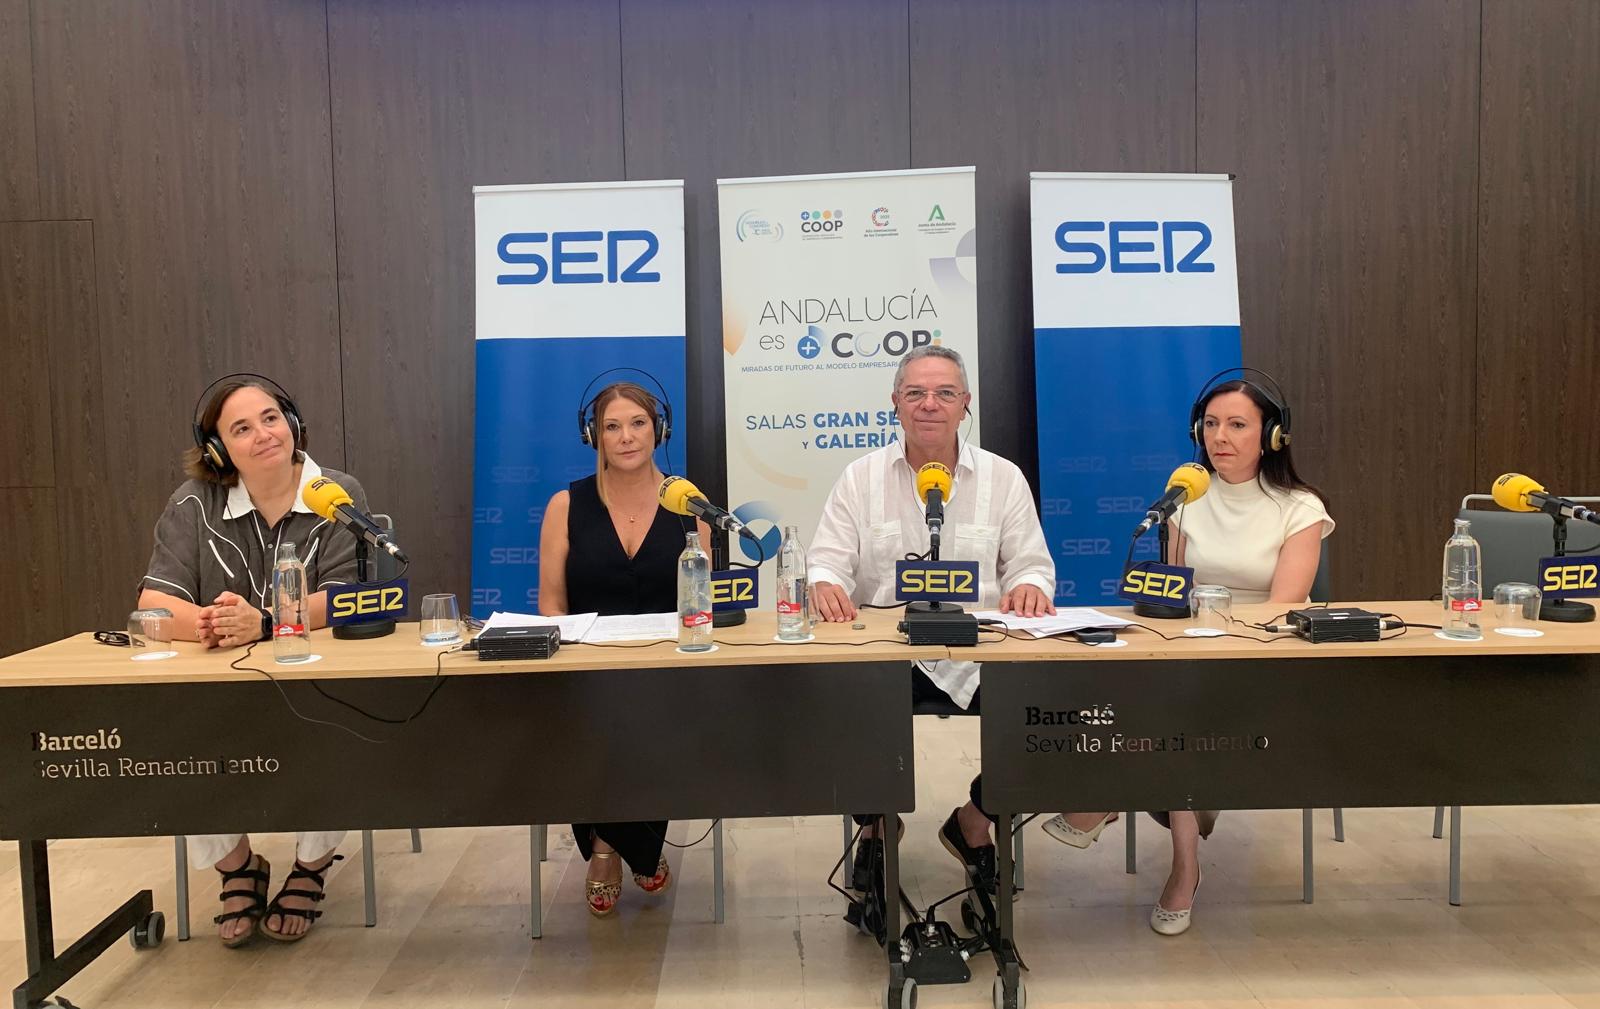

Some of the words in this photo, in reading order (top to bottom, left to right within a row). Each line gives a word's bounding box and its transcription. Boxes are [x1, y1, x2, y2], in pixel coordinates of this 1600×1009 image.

[801, 220, 843, 233] COOP
[1055, 221, 1215, 273] SER
[497, 230, 660, 285] SER
[759, 288, 937, 325] ANDALUCÍA
[759, 334, 785, 350] es
[741, 365, 773, 373] MIRADAS
[785, 363, 814, 371] FUTURO
[826, 362, 857, 370] MODELO
[746, 414, 807, 430] SALAS
[813, 412, 869, 428] GRAN
[876, 411, 900, 426] SE
[815, 429, 899, 449] GALERÍA
[474, 507, 503, 524] ER
[1042, 498, 1073, 515] ER
[1097, 497, 1146, 514] SER
[1062, 538, 1111, 555] SER
[1136, 537, 1160, 553] SE
[901, 569, 973, 593] SER
[1124, 570, 1186, 600] SER
[1543, 564, 1598, 591] SER
[473, 588, 501, 605] ER
[710, 577, 754, 604] ER
[332, 587, 403, 618] SER
[1025, 704, 1115, 726] Barceló
[31, 728, 121, 751] Barceló
[1026, 733, 1101, 753] Sevilla
[33, 758, 111, 779] Sevilla
[118, 756, 280, 777] Renacimiento
